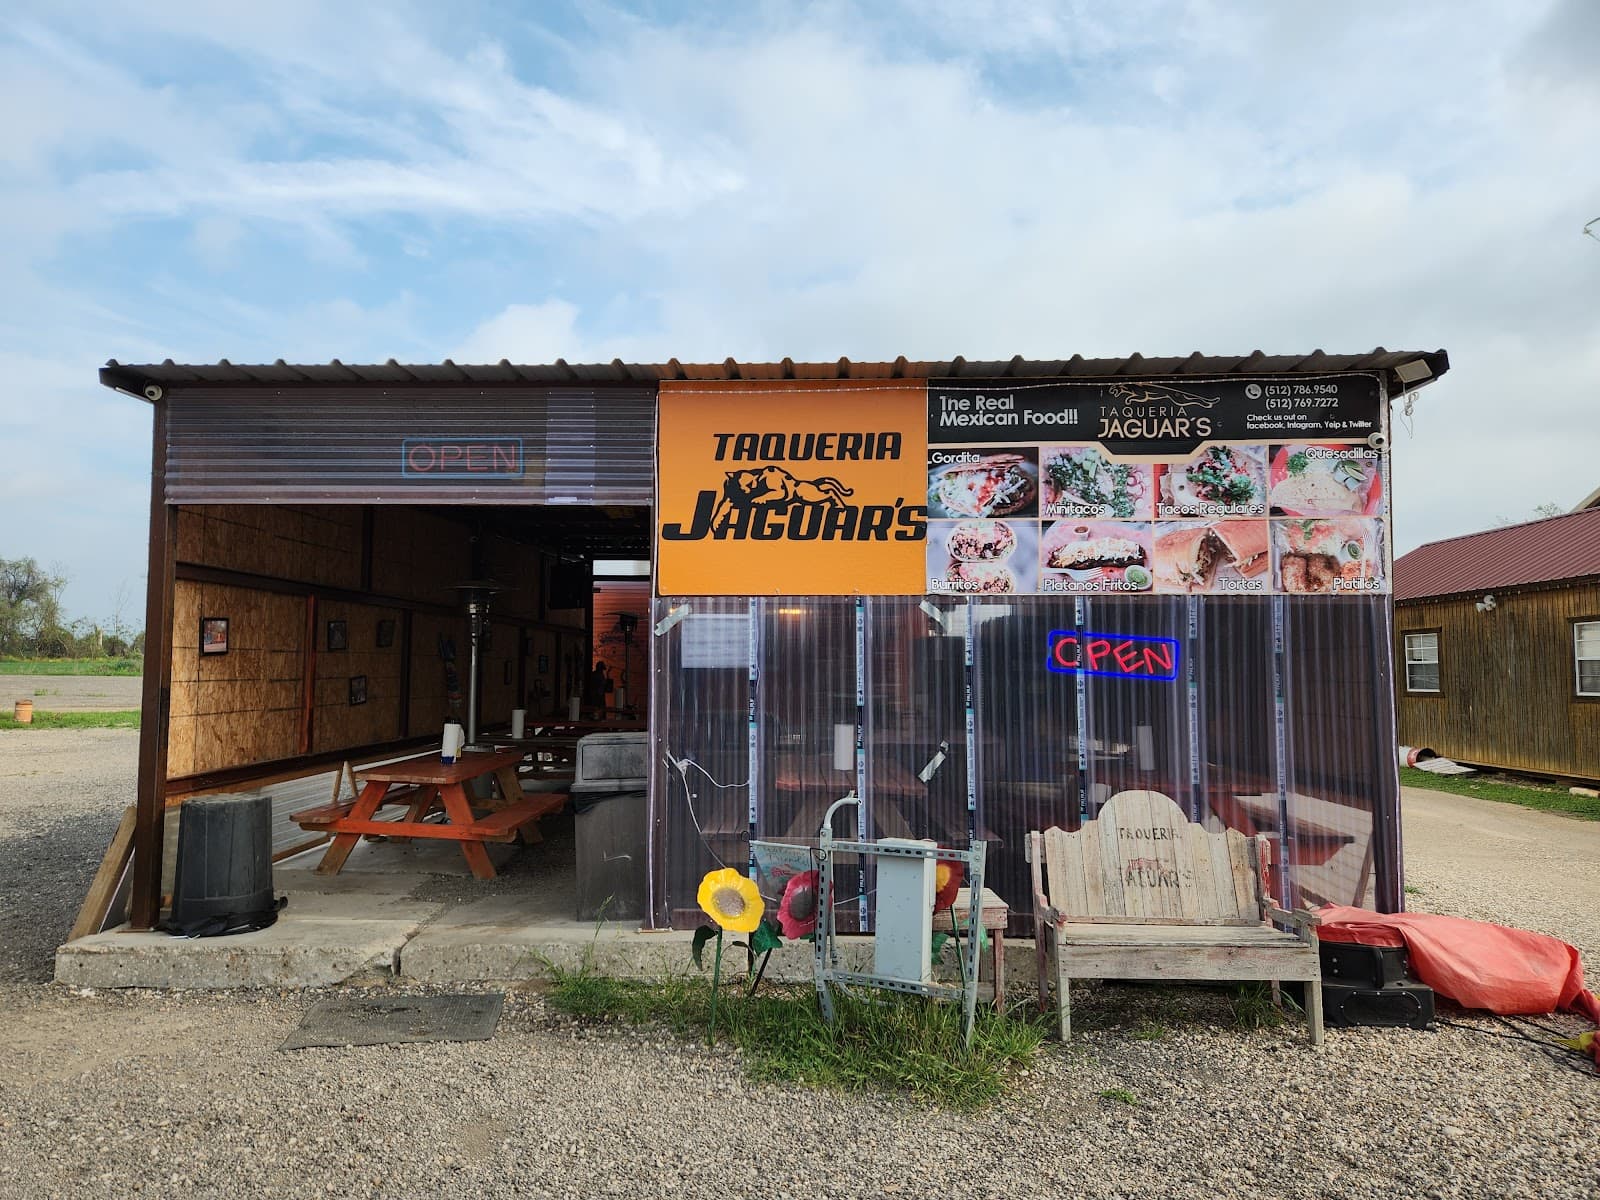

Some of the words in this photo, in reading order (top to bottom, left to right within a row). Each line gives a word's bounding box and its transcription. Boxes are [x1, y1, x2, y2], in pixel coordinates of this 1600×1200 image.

[1264, 384, 1292, 397] (512)
[1293, 384, 1338, 395] 786.9540
[939, 395, 971, 411] The
[975, 394, 1014, 410] Real
[1265, 398, 1292, 410] (512)
[1294, 397, 1339, 408] 769.7272
[939, 410, 1019, 427] Mexican
[1023, 408, 1079, 425] Food!!
[1100, 406, 1188, 418] TAQUERIA
[1246, 413, 1273, 421] Check
[1283, 413, 1296, 421] out
[1349, 420, 1372, 428] Twitter
[713, 432, 902, 461] TAQUERIA
[1305, 447, 1379, 459] Quesadillas
[408, 445, 517, 472] OPEN
[931, 451, 980, 464] Gordita
[661, 490, 928, 541] JAGUAR'S
[1045, 503, 1105, 515] Minitacos
[1156, 502, 1196, 515] Tacos
[1199, 502, 1265, 516] Regulares
[931, 578, 978, 591] Burritos
[1044, 579, 1099, 591] Platanos
[1102, 579, 1138, 591] Fritos
[1219, 578, 1263, 591] Tortas
[1332, 578, 1380, 590] Platillos
[1055, 637, 1172, 674] OPEN
